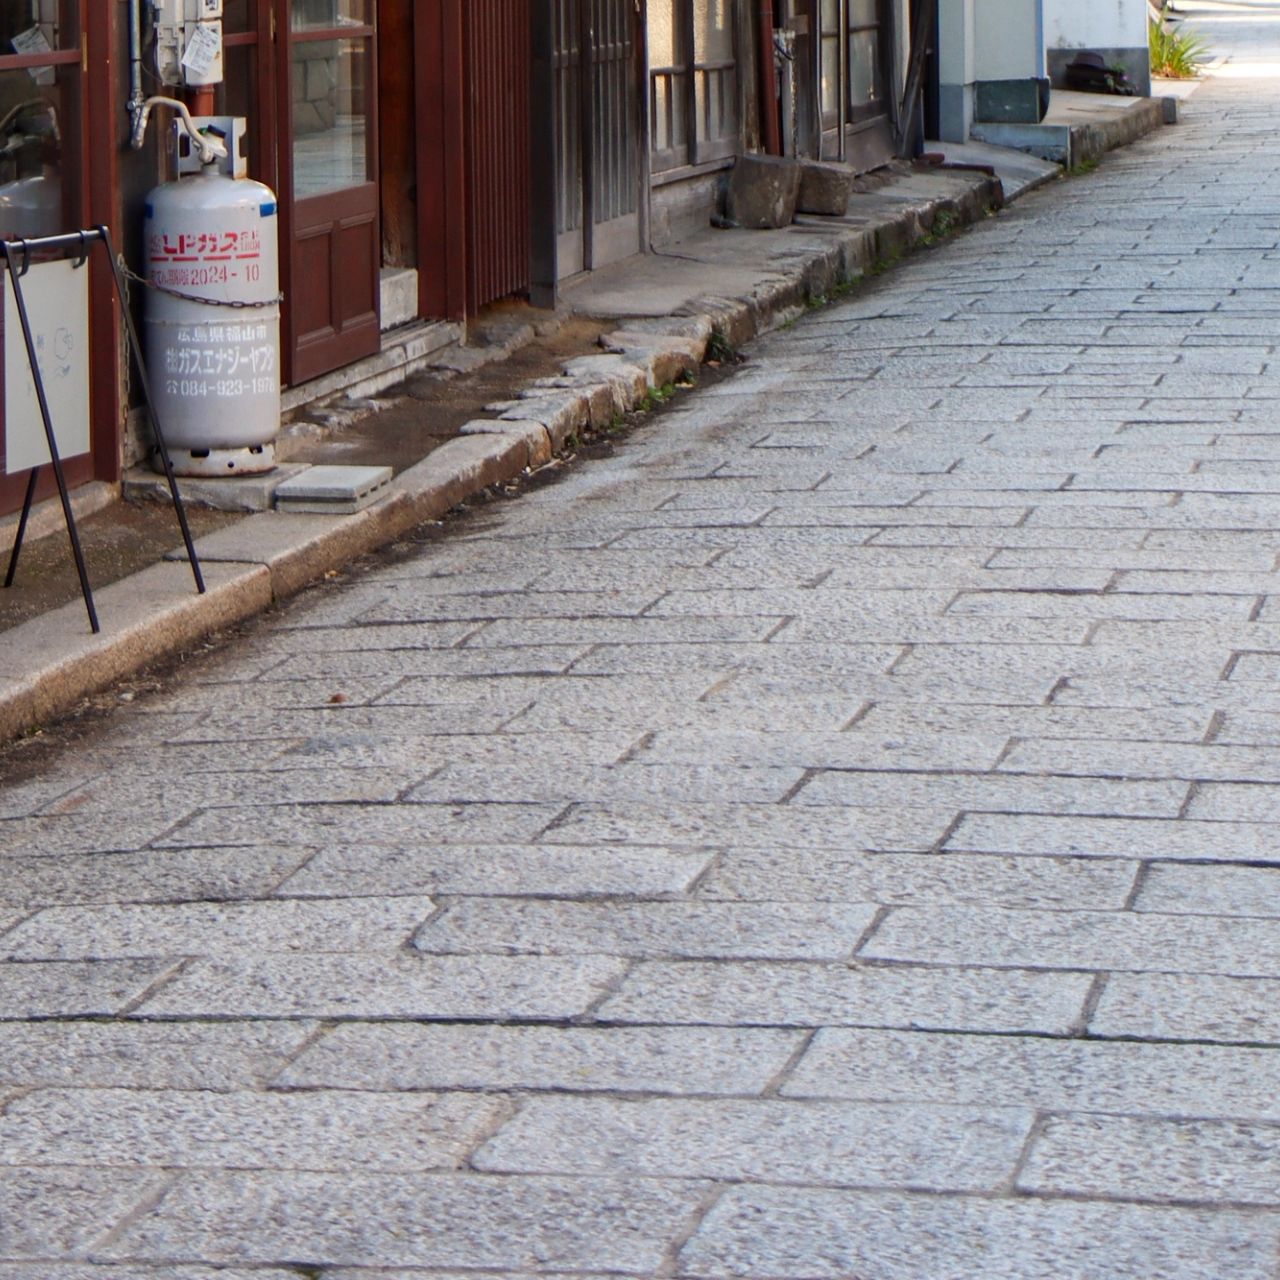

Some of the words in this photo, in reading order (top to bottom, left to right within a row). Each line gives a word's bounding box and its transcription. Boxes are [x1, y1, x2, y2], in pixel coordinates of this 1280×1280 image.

[163, 232, 238, 255] LPガス
[177, 324, 267, 342] 広島県福山市
